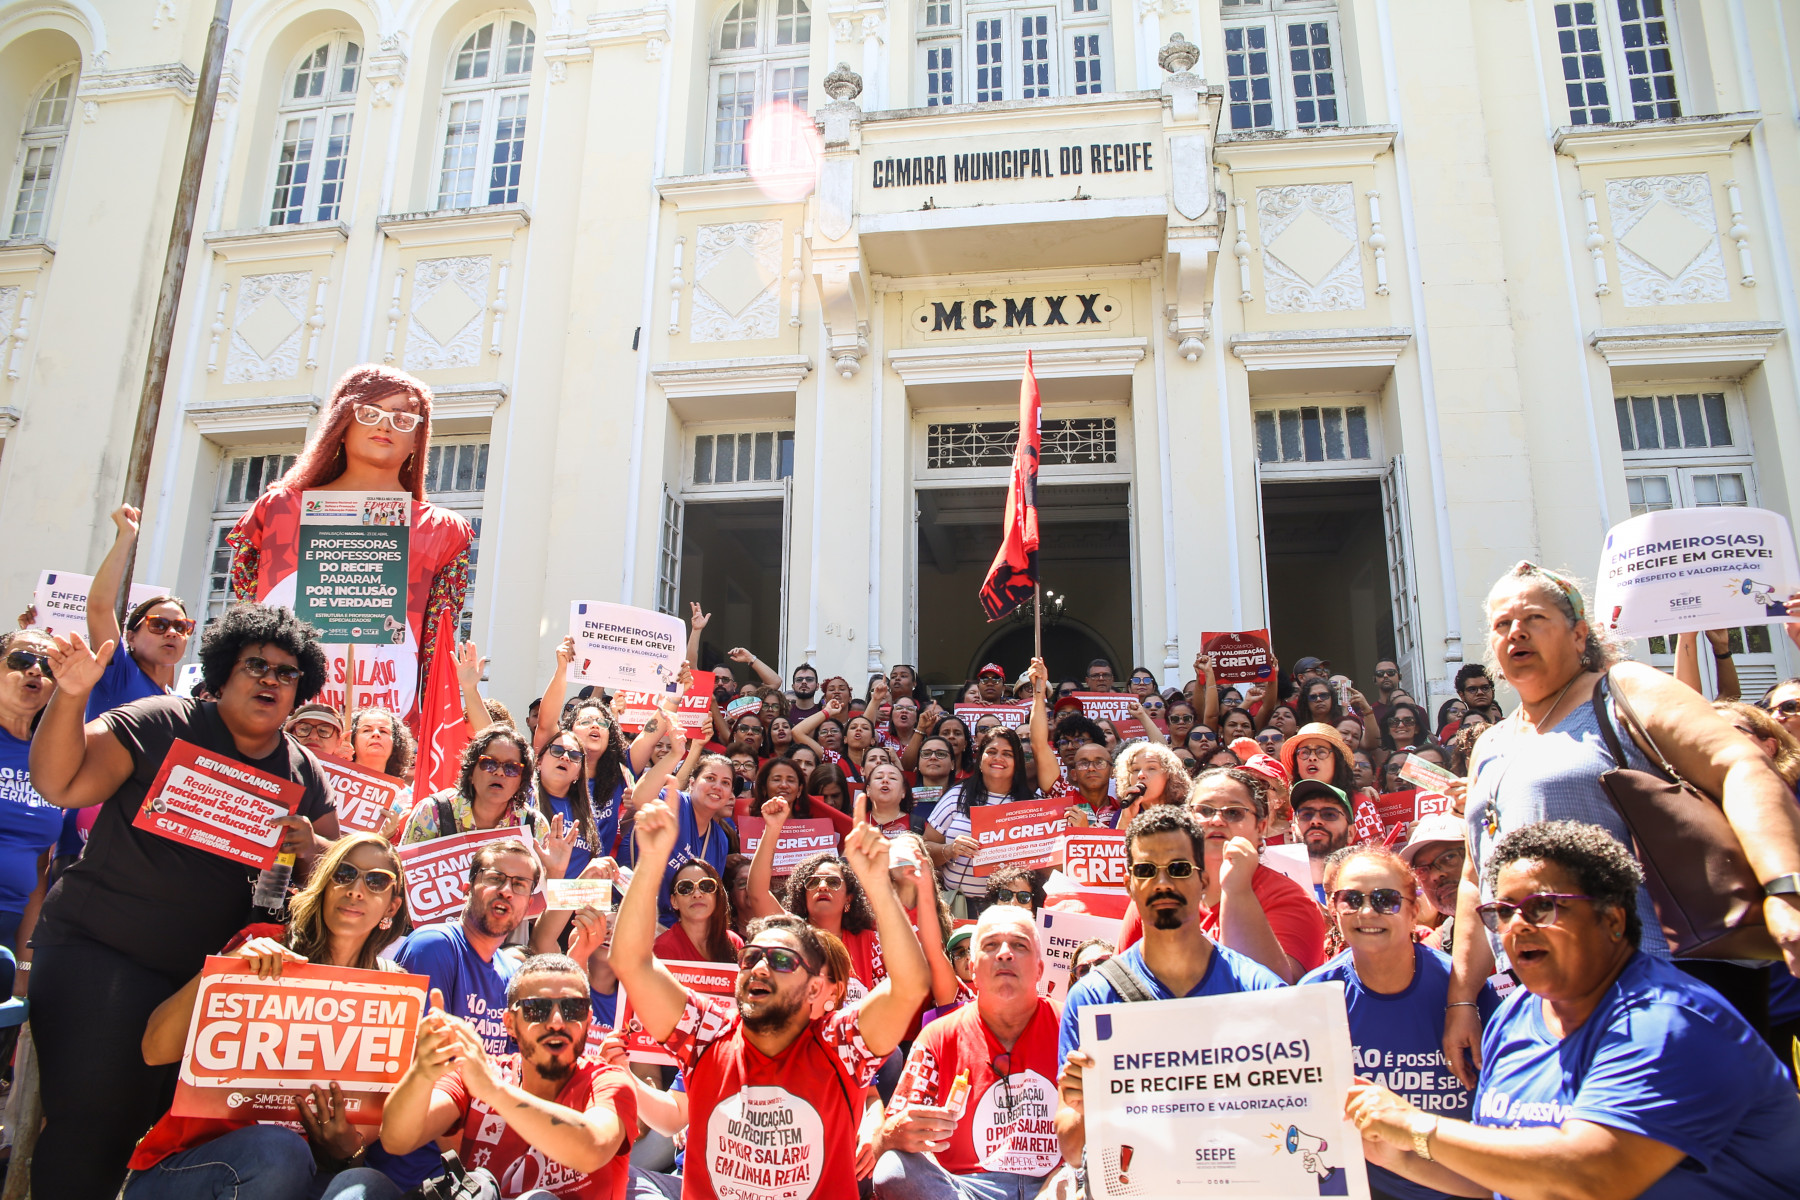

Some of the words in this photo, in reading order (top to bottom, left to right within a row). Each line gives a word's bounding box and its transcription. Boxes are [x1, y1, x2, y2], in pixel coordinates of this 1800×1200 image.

[954, 149, 1053, 182] MUNICIPAL
[1060, 146, 1082, 175] DO
[1090, 142, 1152, 174] RECIFE
[931, 293, 1101, 332] MCMXX
[311, 539, 397, 549] PROFESSORAS
[1611, 534, 1764, 564] ENFERMEIROS(AS)
[306, 551, 313, 560] E
[316, 551, 401, 560] PROFESSORES
[1609, 567, 1623, 579] DE
[1627, 555, 1678, 573] RECIFE
[1682, 551, 1706, 563] EM
[1711, 548, 1773, 559] GREVE!
[319, 563, 339, 572] DO
[341, 563, 383, 572] RECIFE
[1617, 579, 1633, 588] POR
[1635, 571, 1676, 584] RESPEITO
[1687, 563, 1760, 576] VALORIZAÇÃO!
[320, 575, 381, 584] PARARAM
[306, 586, 332, 595] POR
[335, 584, 397, 596] INCLUSÃO
[63, 603, 87, 612] RECI
[310, 598, 327, 607] DE
[329, 598, 392, 607] VERDADE!
[1670, 596, 1702, 608] SEEPE
[585, 621, 672, 643] ENFERMEIROS(AS)
[597, 633, 628, 643] RECIFE
[631, 638, 643, 646] EM
[645, 640, 675, 651] GREVE!
[631, 649, 668, 659] VALORIZAÇÃO!
[1220, 655, 1266, 667] GREVE!
[194, 756, 281, 794] REIVINDICAMOS:
[166, 784, 216, 810] nacional
[217, 801, 263, 824] Salarial
[183, 775, 234, 800] Reajuste
[234, 795, 249, 806] do
[250, 800, 275, 816] Piso
[362, 786, 389, 804] EM
[166, 797, 203, 815] saúde
[203, 808, 212, 818] e
[212, 811, 271, 838] educação!
[996, 814, 1028, 823] PROFESSORES
[1006, 808, 1039, 817] PROFESSORAS
[156, 818, 187, 835] CUT
[216, 836, 231, 845] DOS
[776, 835, 833, 849] GREVE!
[979, 829, 1005, 844] EM
[189, 834, 230, 852] SERVIDORES
[230, 847, 240, 855] DO
[240, 851, 264, 863] RECIFE
[1047, 948, 1060, 957] DE
[1053, 962, 1066, 970] POR
[207, 992, 357, 1024] ESTAMOS
[361, 1000, 408, 1026] EM
[195, 1020, 405, 1074] GREVE!
[637, 1035, 657, 1045] CU
[1114, 1039, 1310, 1071] ENFERMEIROS(AS)
[1352, 1046, 1381, 1068] ÃO
[1384, 1051, 1393, 1067] É
[1110, 1079, 1134, 1094] DE
[1142, 1075, 1207, 1092] RECIFE
[1213, 1072, 1240, 1089] EM
[1247, 1066, 1323, 1087] GREVE!
[994, 1112, 1005, 1125] DO
[1032, 1104, 1048, 1117] TEM
[1126, 1105, 1148, 1115] POR
[1152, 1102, 1204, 1114] RESPEITO
[1209, 1102, 1215, 1112] E
[1218, 1096, 1307, 1112] VALORIZAÇÃO!
[728, 1119, 741, 1136] DO
[742, 1124, 777, 1146] RECIFE
[778, 1128, 802, 1146] TEM
[986, 1128, 993, 1141] O
[719, 1136, 726, 1152] O
[728, 1139, 751, 1163] PIOR
[754, 1144, 811, 1165] SALÁRIO
[1030, 1138, 1057, 1153] RETA!
[1196, 1148, 1236, 1161] SEEPE
[715, 1156, 734, 1175] EM
[735, 1161, 771, 1187] LINHA
[775, 1164, 810, 1187] RETA!
